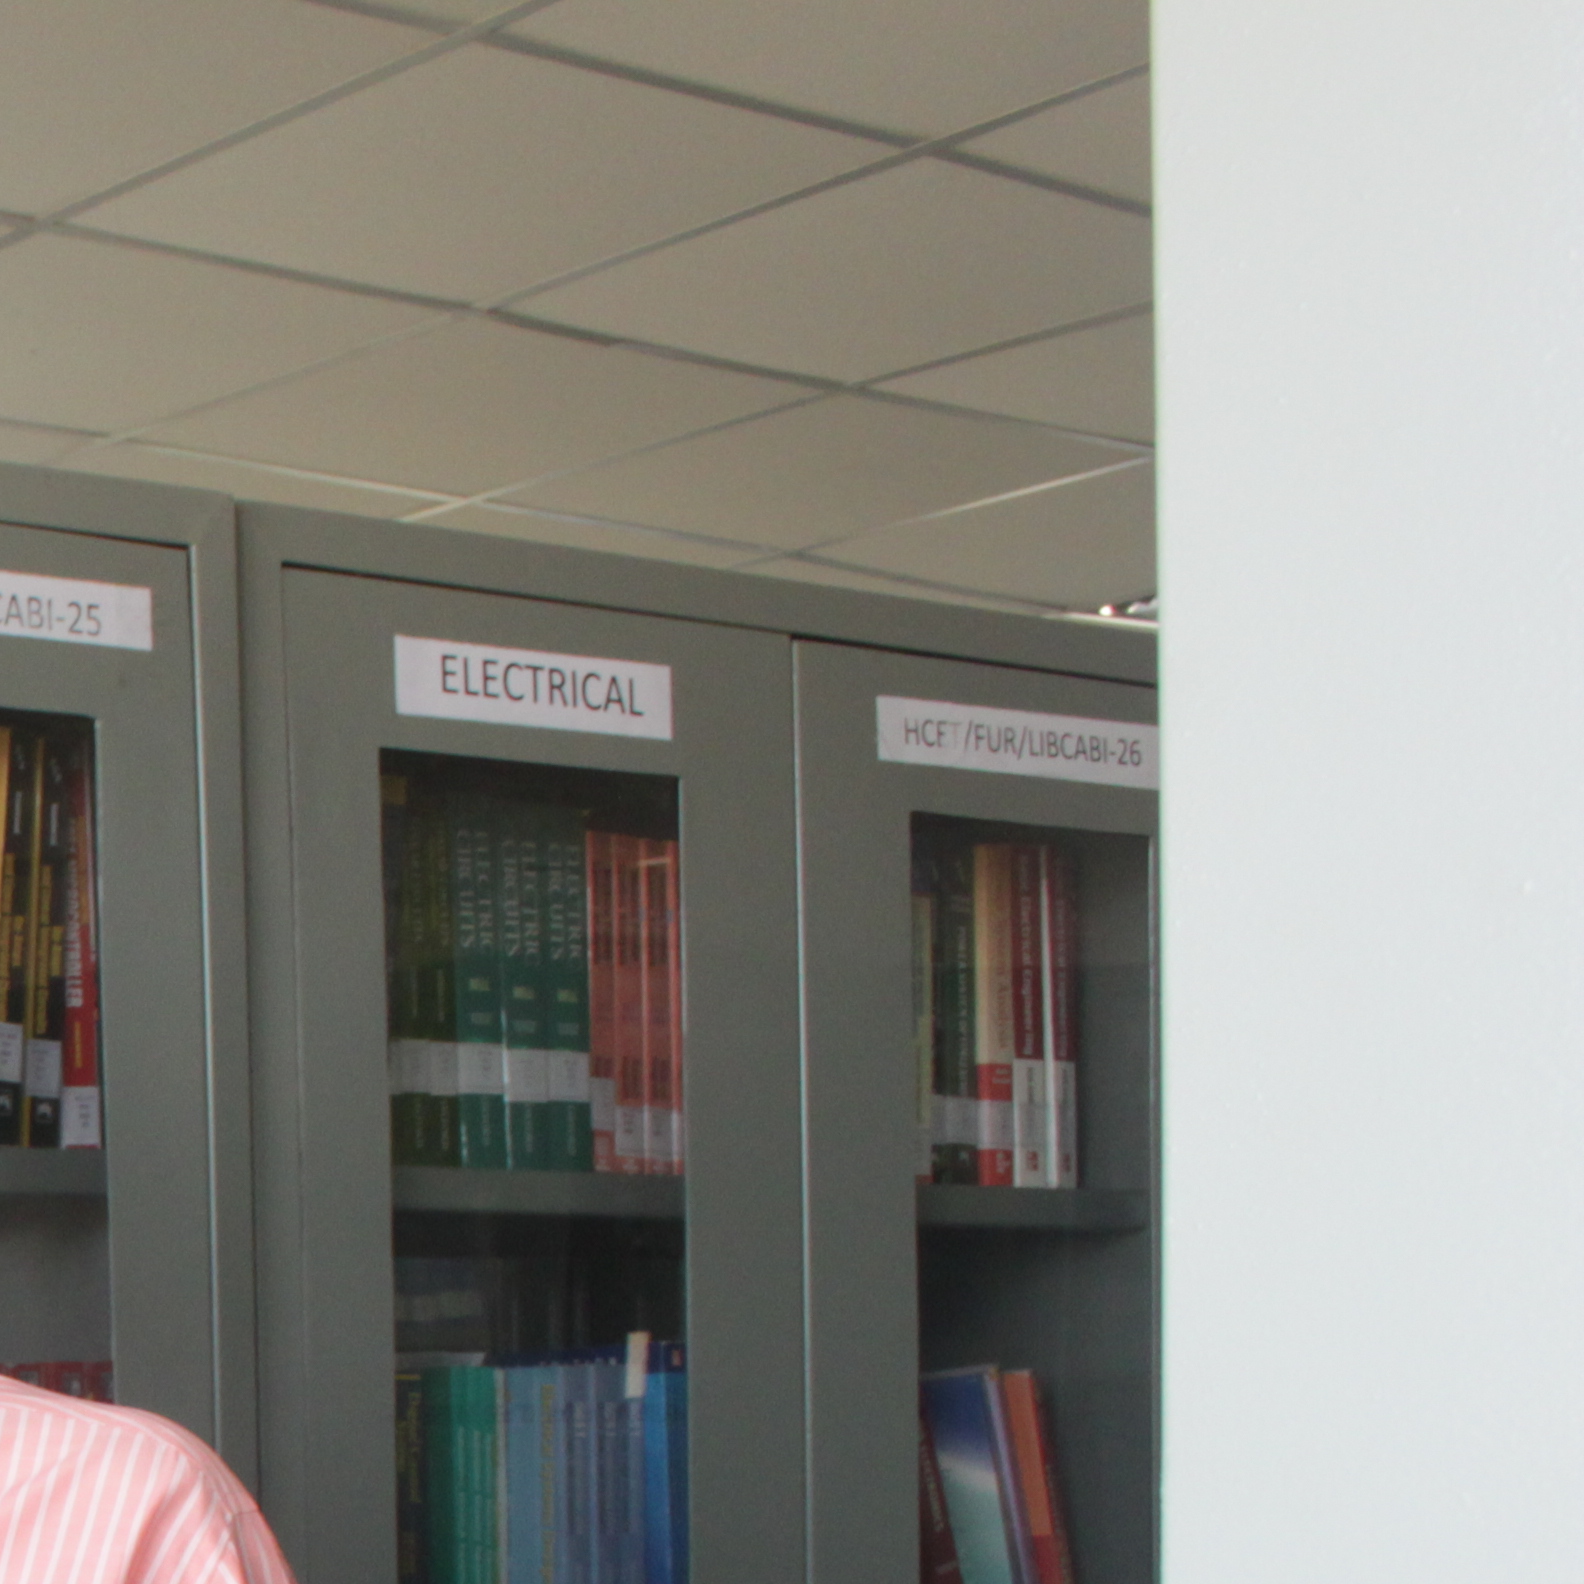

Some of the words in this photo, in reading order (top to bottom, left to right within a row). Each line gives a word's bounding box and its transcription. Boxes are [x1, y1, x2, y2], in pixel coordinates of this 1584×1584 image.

[440, 653, 645, 718] ELECTRICAL
[903, 717, 1143, 767] HCET/FUR/LIBCABI-26
[456, 829, 475, 949] CIRCUITS
[502, 839, 521, 958] CIRCUITS
[521, 841, 539, 957] ELECTRIC
[548, 843, 566, 961] CIRCUITS
[565, 843, 583, 960] ELECTRIC
[1020, 968, 1037, 1056] Engineering
